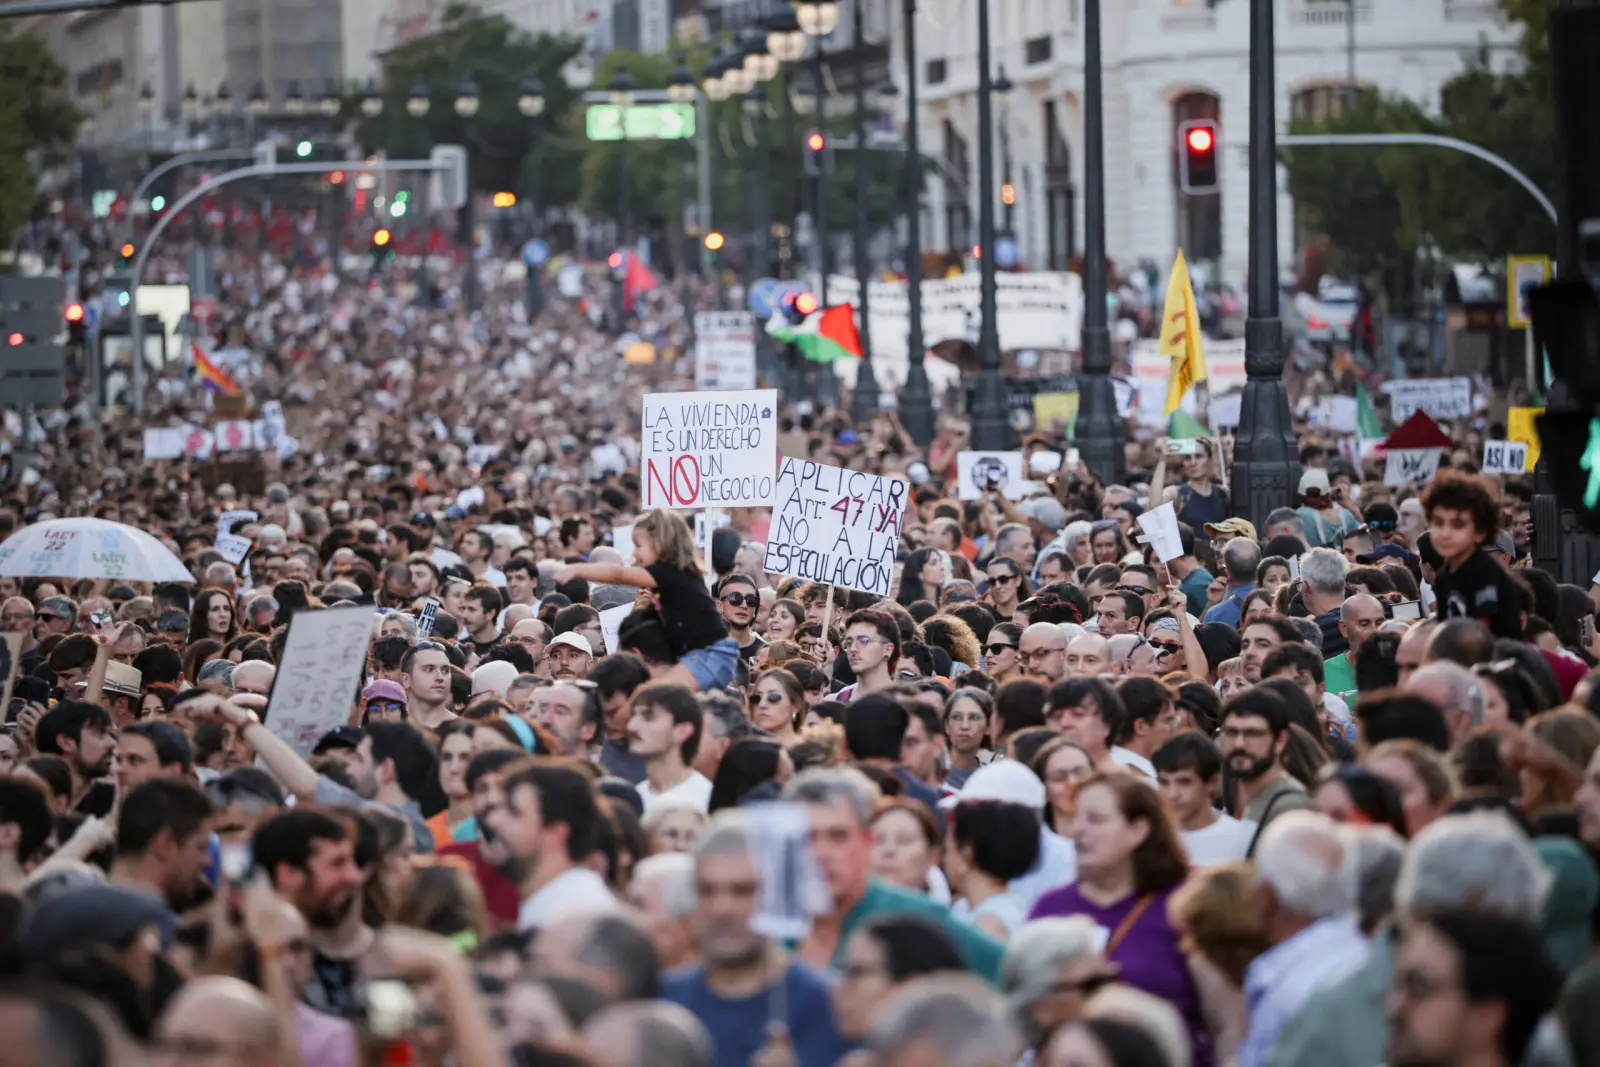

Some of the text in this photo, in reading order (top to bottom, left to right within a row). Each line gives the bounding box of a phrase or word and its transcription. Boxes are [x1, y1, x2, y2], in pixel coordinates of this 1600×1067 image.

[645, 402, 759, 428] LA VIVIENDA
[652, 427, 761, 452] ES UN DERECHO
[647, 454, 700, 506] NO
[700, 453, 723, 477] UN
[701, 474, 771, 501] NEGOCIO
[777, 457, 904, 508] APLICAR
[830, 496, 865, 527] 47
[776, 514, 897, 565] NO A LA
[763, 541, 891, 596] ESPECULACIÓN
